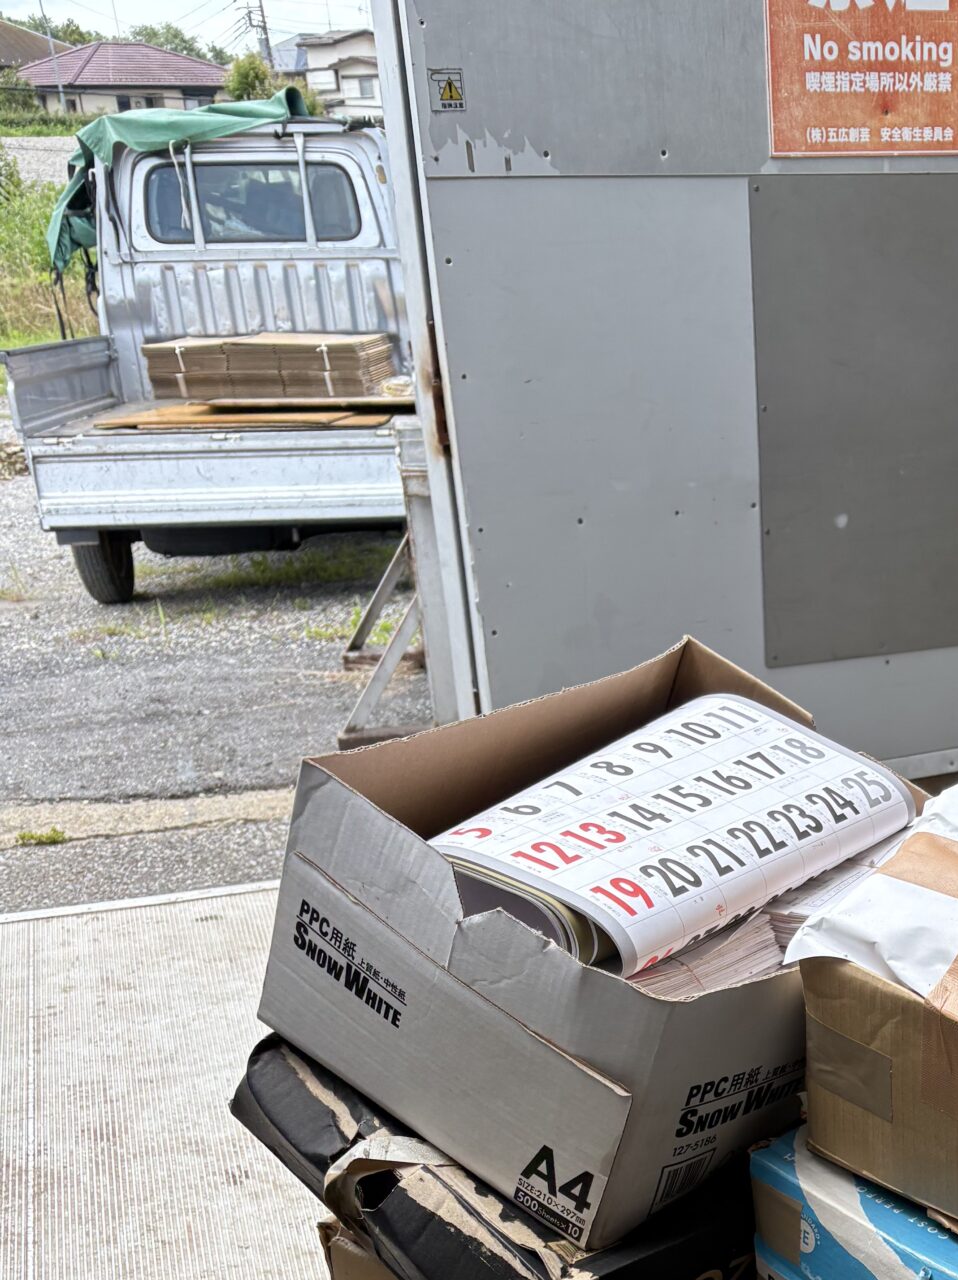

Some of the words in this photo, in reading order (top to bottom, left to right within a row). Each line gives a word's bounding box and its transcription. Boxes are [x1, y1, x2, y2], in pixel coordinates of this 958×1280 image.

[803, 33, 839, 61] No
[847, 35, 953, 67] smoking
[805, 71, 952, 93] 喫煙指定場所以外厳禁
[449, 827, 493, 839] 5
[500, 804, 542, 816] 6
[542, 780, 583, 797] 7
[590, 761, 634, 776] 8
[632, 742, 673, 759] 9
[664, 722, 721, 745] 10
[703, 705, 759, 730] 11
[510, 841, 583, 871] 12
[559, 822, 626, 850] 13
[606, 803, 672, 831] 14
[651, 785, 713, 813] 15
[693, 769, 752, 796] 16
[732, 751, 786, 780] 17
[769, 737, 826, 765] 18
[589, 877, 655, 917] 19
[639, 857, 703, 898] 20
[686, 838, 746, 877] 21
[726, 820, 788, 859] 22
[767, 803, 823, 841] 23
[804, 786, 860, 825] 24
[840, 771, 893, 809] 25
[299, 898, 357, 961] PPC用紙
[684, 1065, 763, 1107] PPC用紙
[672, 1134, 717, 1158] 127-5186
[520, 1144, 594, 1214] A4
[856, 1185, 904, 1214] PERFO
[908, 1216, 949, 1240] COST
